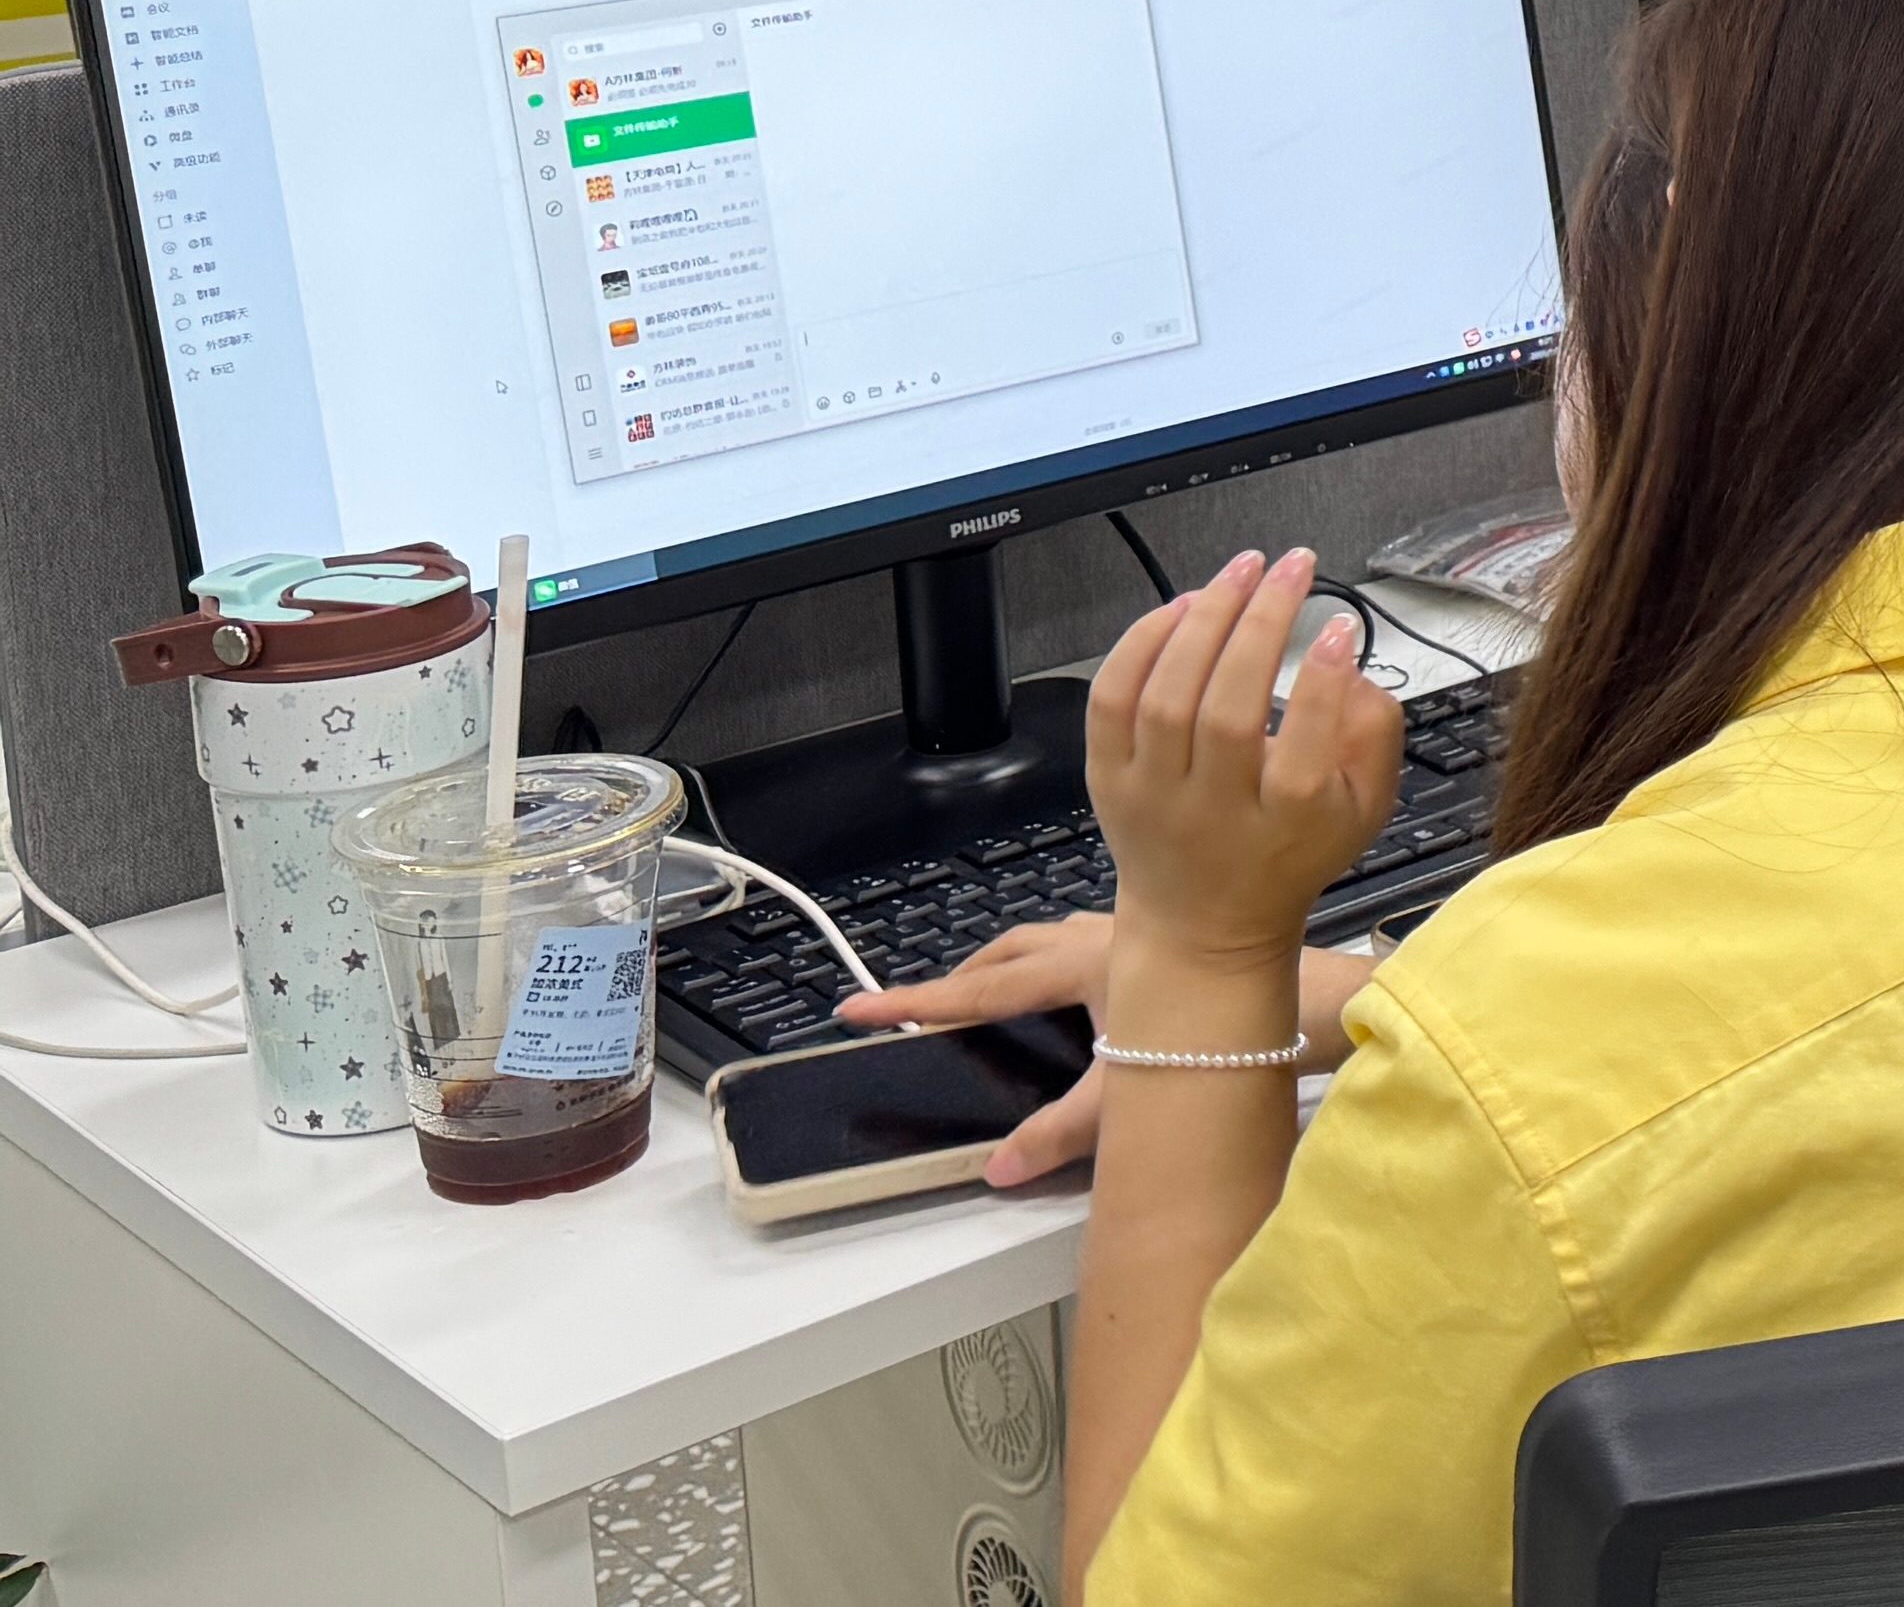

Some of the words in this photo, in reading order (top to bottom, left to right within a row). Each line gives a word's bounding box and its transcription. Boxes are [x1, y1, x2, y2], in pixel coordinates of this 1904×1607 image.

[147, 3, 170, 14] 会议
[751, 10, 813, 28] 文件传输助手
[160, 79, 196, 93] 工作台
[949, 508, 1022, 539] PHILIPS
[535, 954, 584, 974] 212
[531, 977, 584, 991] 加浓美式
